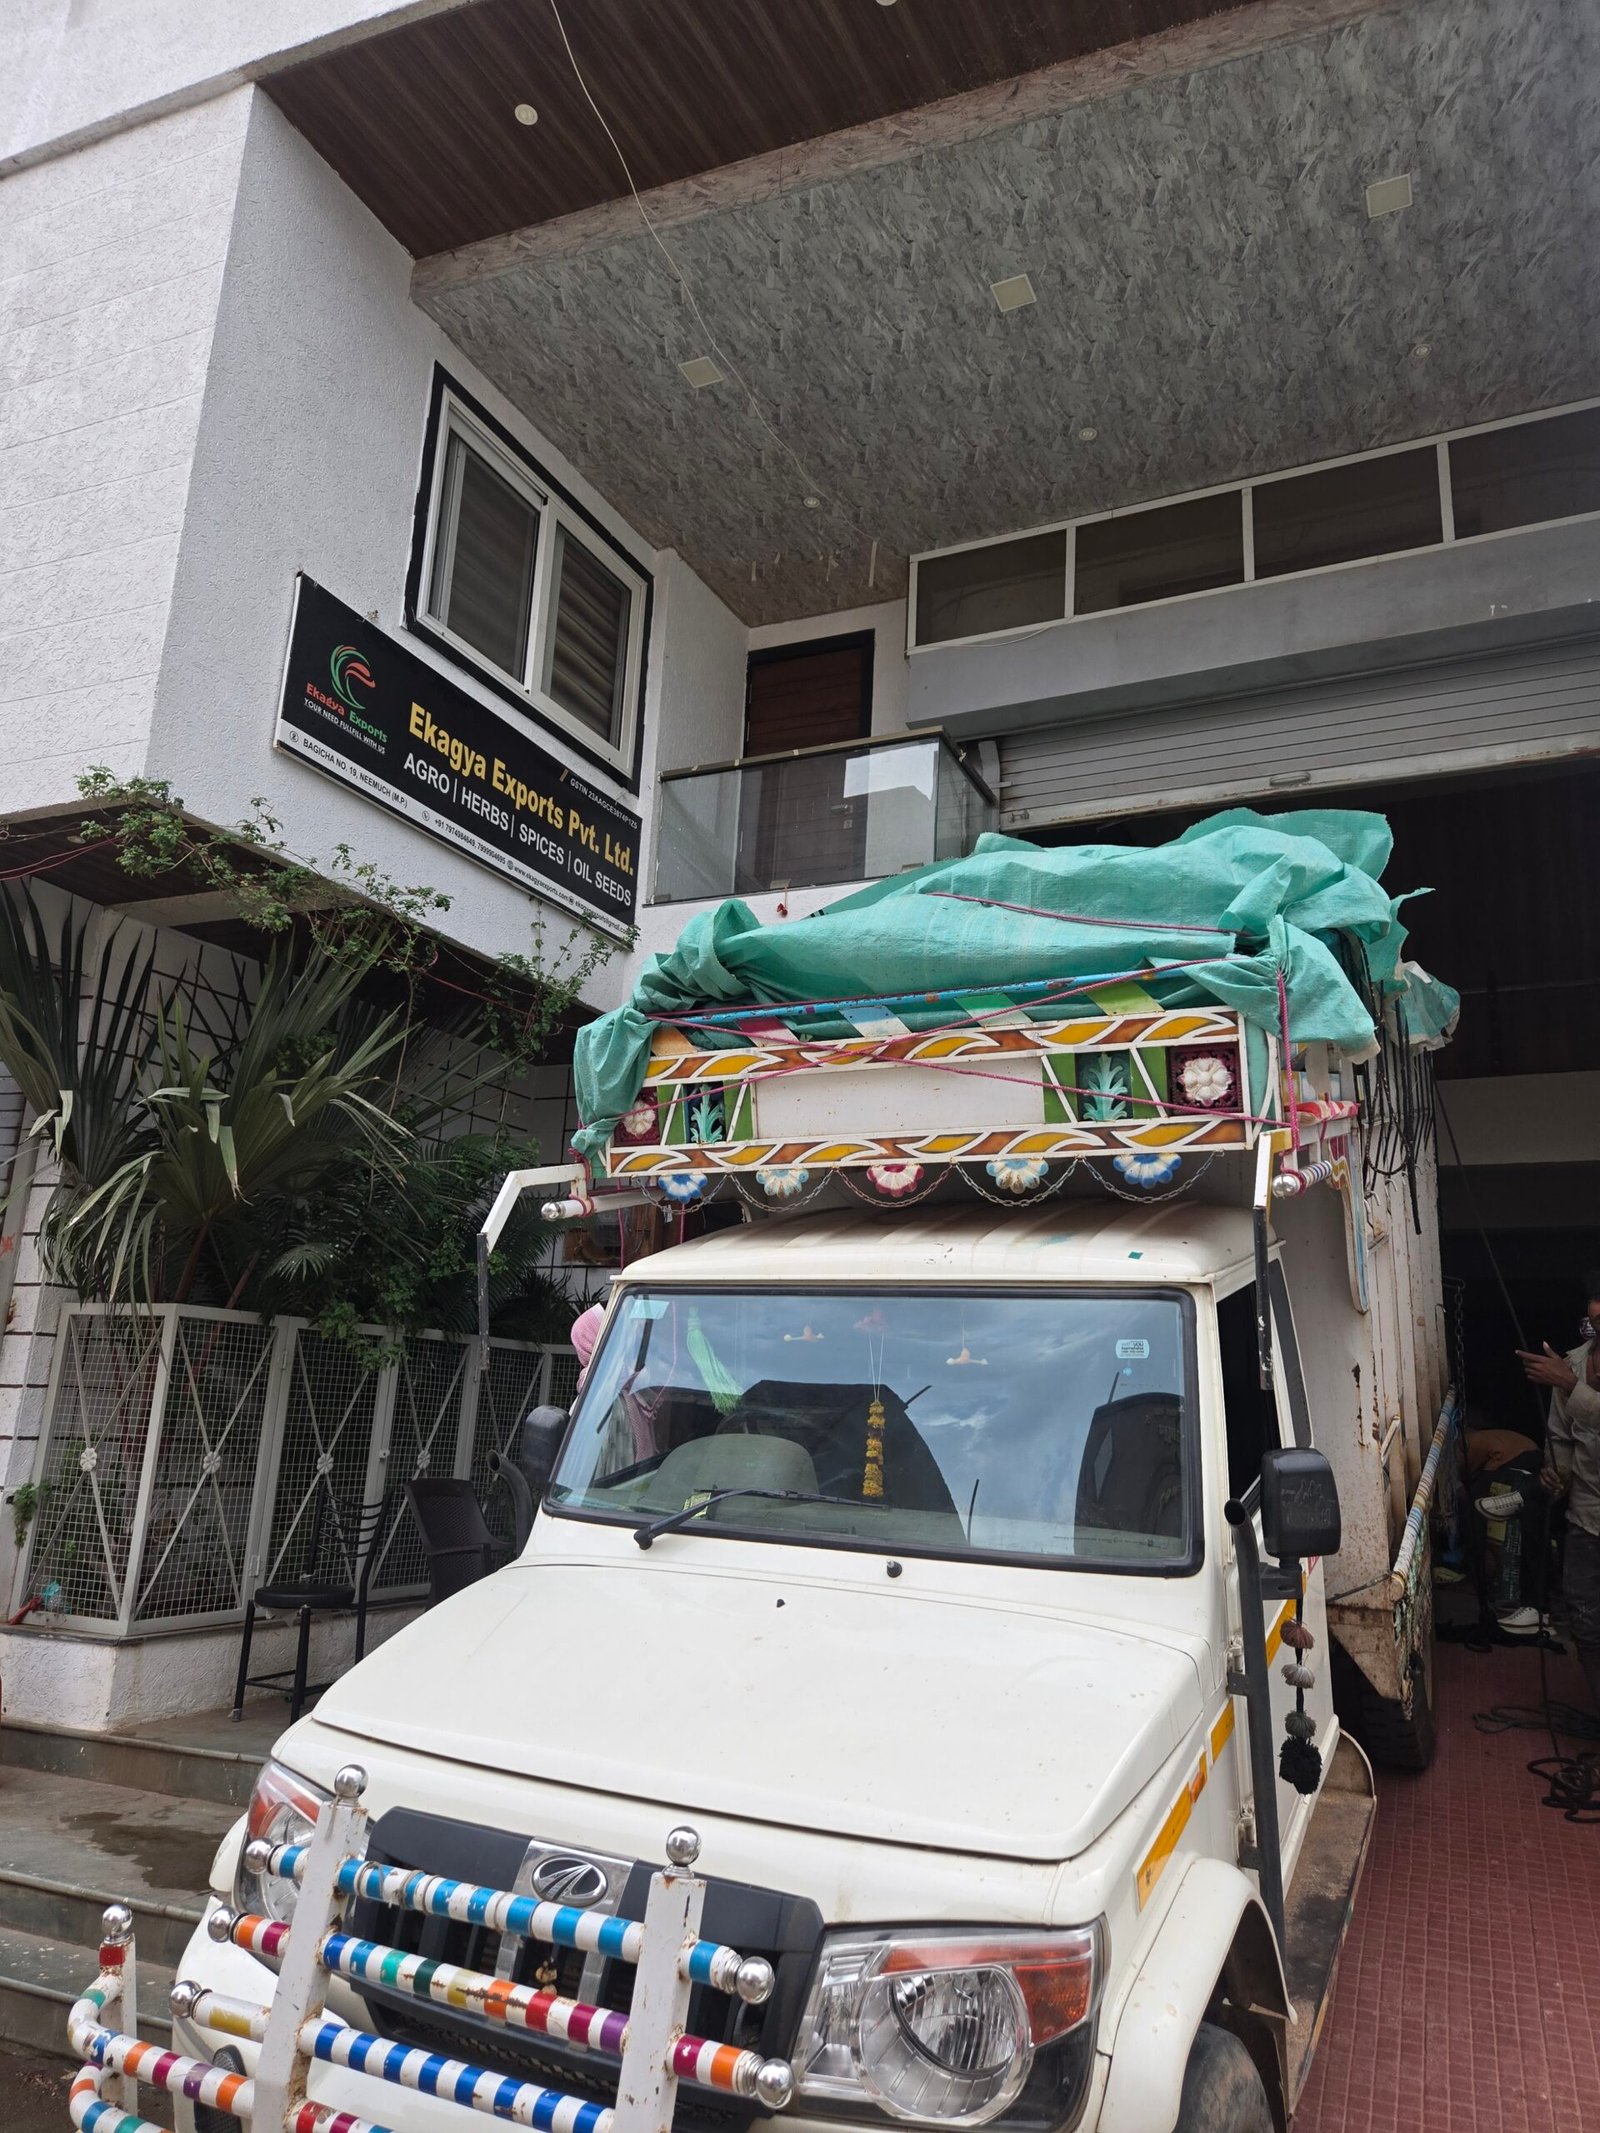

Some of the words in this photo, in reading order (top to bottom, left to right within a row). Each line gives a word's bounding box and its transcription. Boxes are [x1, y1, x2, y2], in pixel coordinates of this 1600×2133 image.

[304, 698, 323, 714] YOUR
[322, 709, 340, 724] NEED
[340, 720, 363, 741] FULLFILL
[362, 735, 380, 749] WITH
[377, 744, 387, 755] US
[306, 682, 346, 717] Ekagya
[349, 710, 389, 743] Exports
[303, 738, 335, 764] BAGICHA
[335, 758, 348, 772] NO.
[349, 765, 359, 779] 19,
[359, 772, 392, 797] NEEMUCH
[391, 790, 408, 809] (M.P.)
[409, 701, 486, 780] Ekagya
[492, 757, 564, 830] Exports
[568, 808, 600, 855] Pvt.
[604, 833, 634, 876] Ltd.
[570, 778, 588, 796] GSTIN
[403, 752, 450, 794] AGRO
[461, 786, 509, 831] HERBS
[519, 823, 565, 865] SPICES
[573, 858, 593, 884] OIL
[595, 871, 632, 907] SEEDS
